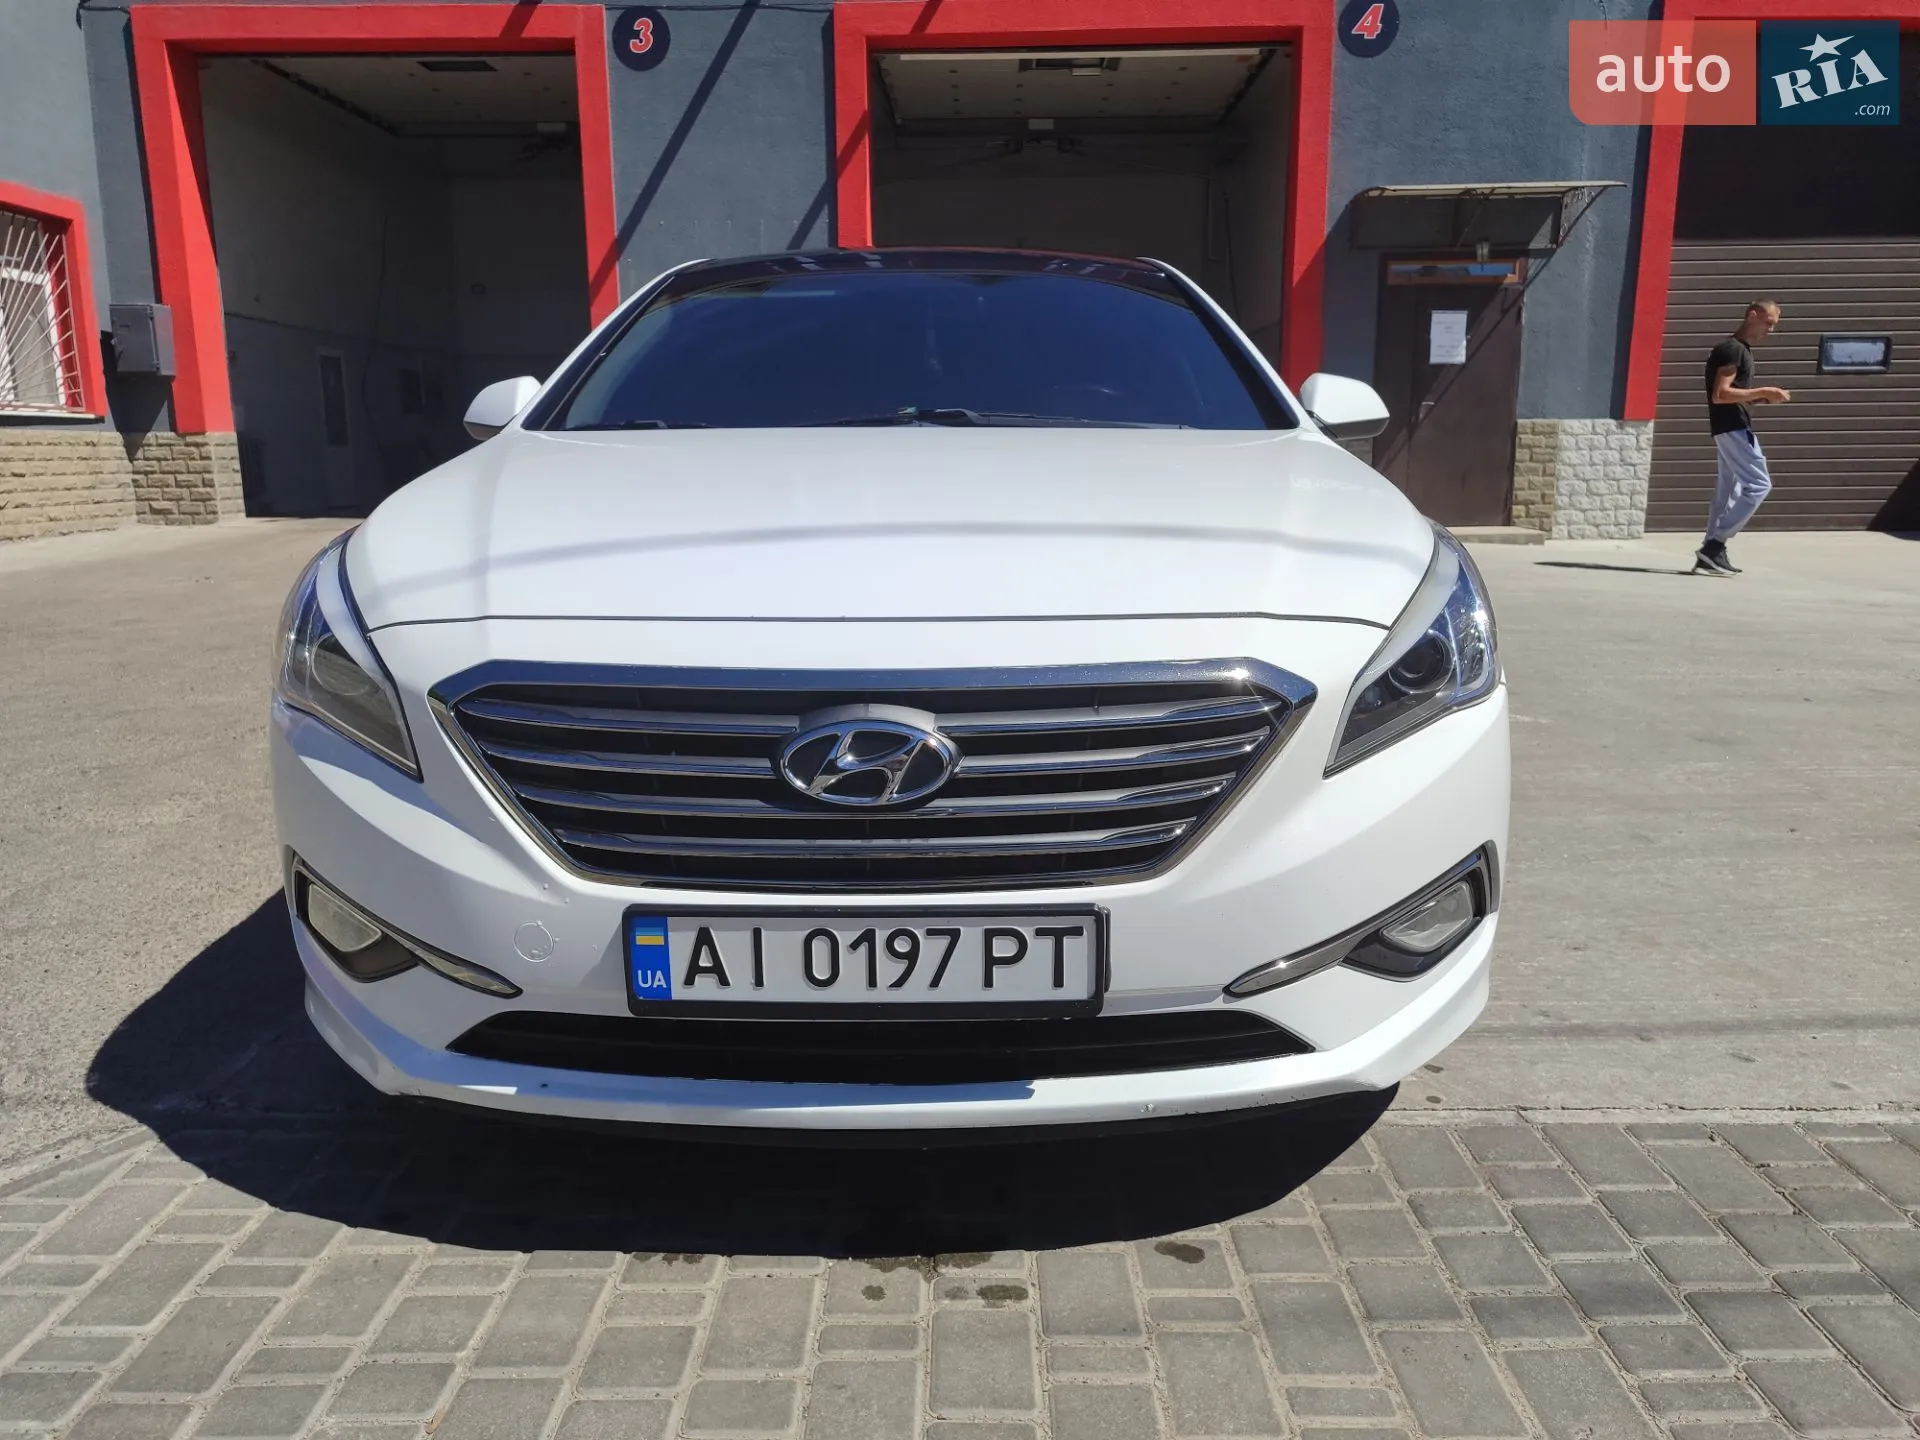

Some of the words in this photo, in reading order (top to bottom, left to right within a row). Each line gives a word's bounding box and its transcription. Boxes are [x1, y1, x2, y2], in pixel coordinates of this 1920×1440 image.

[630, 18, 653, 53] 3
[1352, 4, 1384, 39] 4
[683, 926, 765, 988] AI
[803, 927, 961, 989] 0197
[983, 927, 1084, 988] PT
[637, 970, 667, 989] UA
